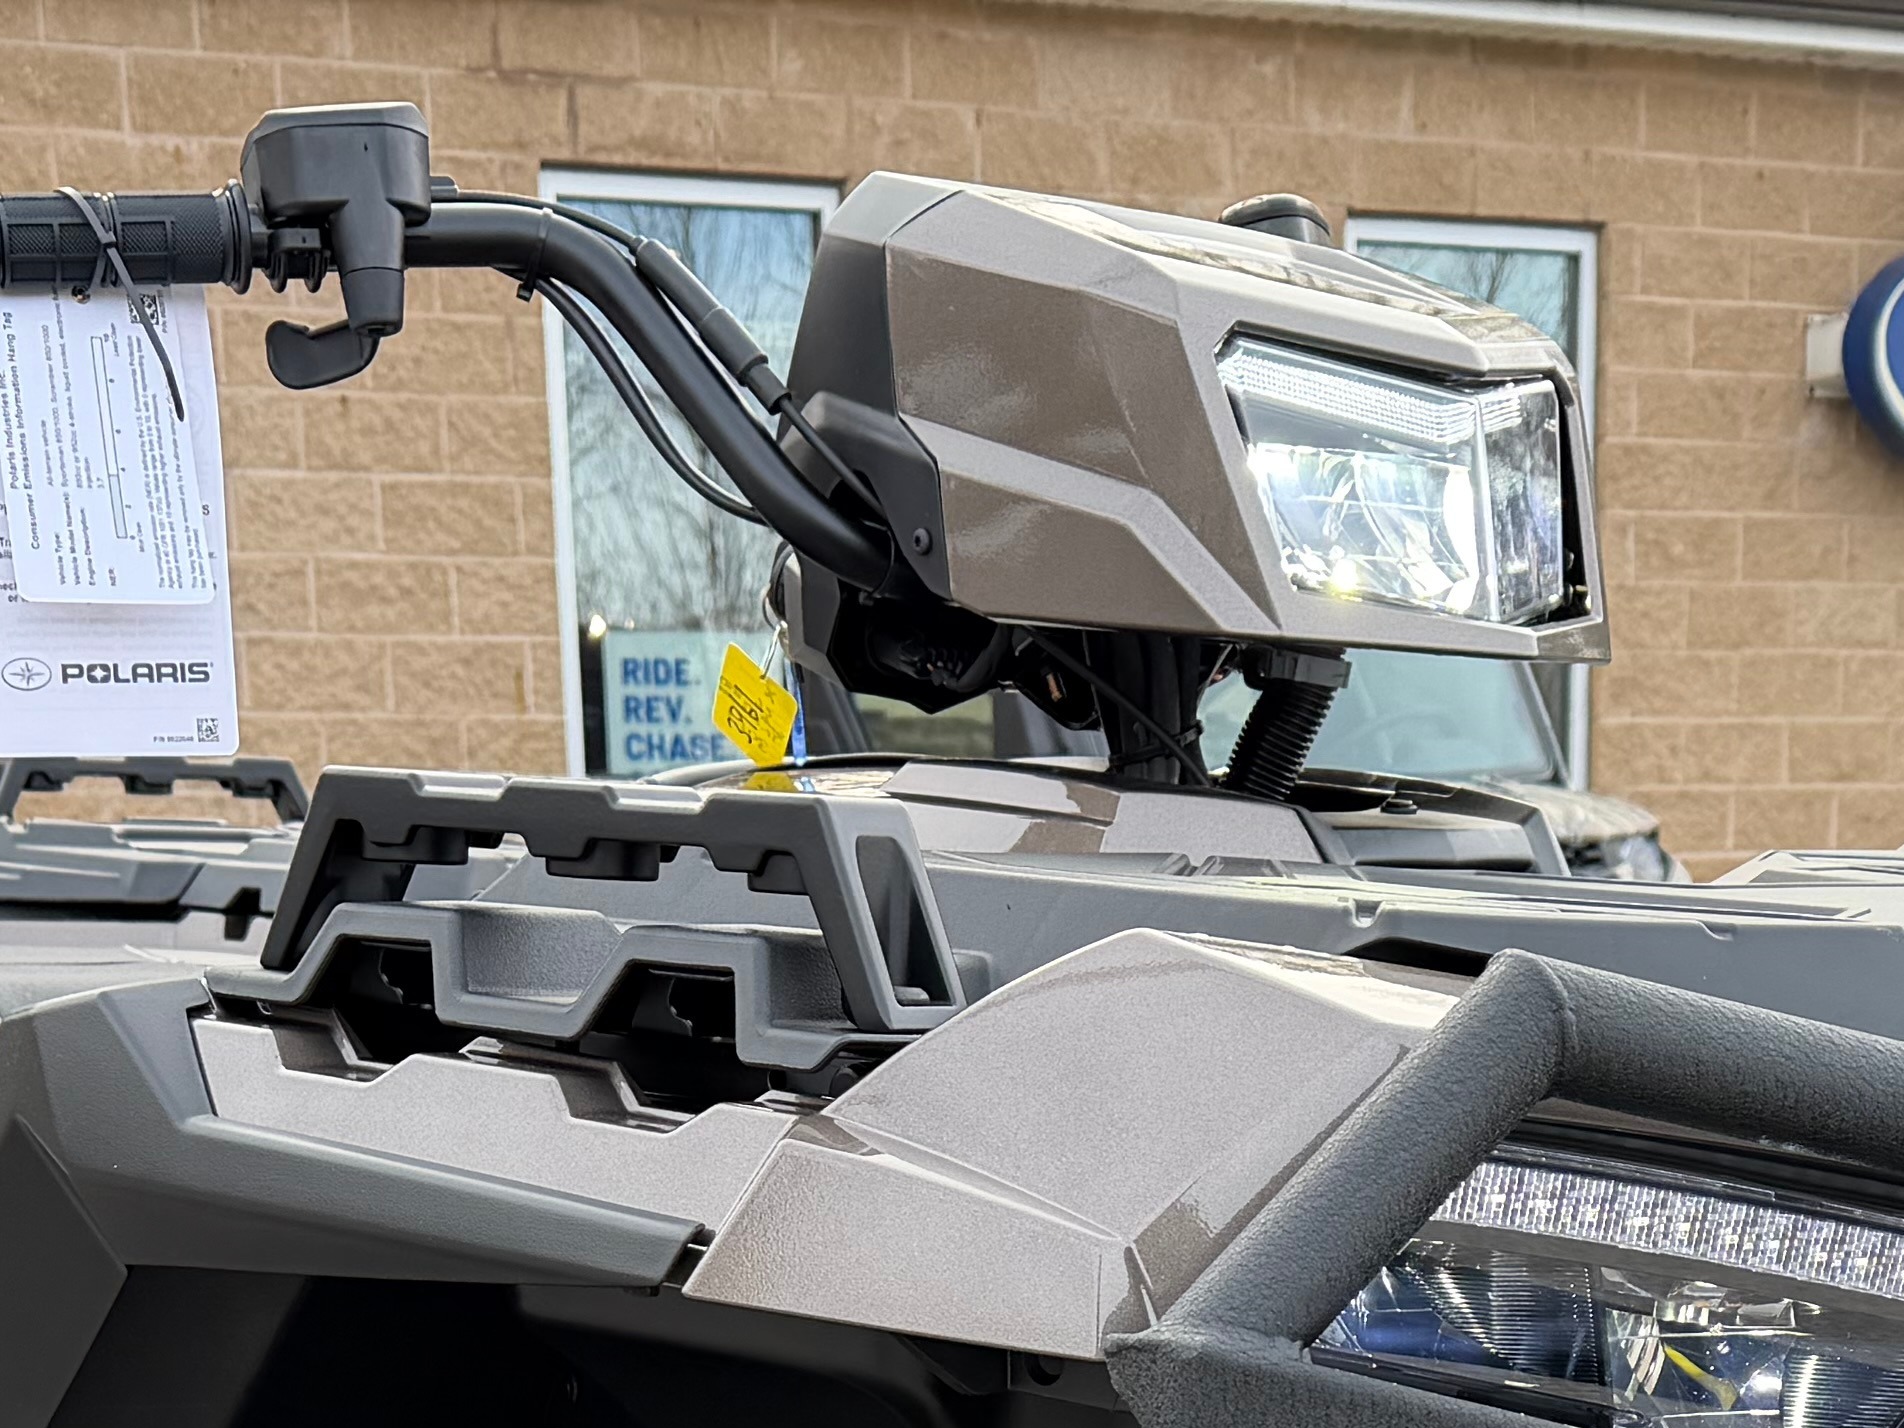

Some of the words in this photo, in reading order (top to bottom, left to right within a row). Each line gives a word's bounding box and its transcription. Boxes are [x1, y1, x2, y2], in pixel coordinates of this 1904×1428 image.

[1, 311, 13, 330] Tag
[4, 333, 17, 362] Hang
[9, 365, 24, 428] Information
[0, 392, 14, 448] Industries
[6, 451, 19, 489] Polaris
[17, 432, 32, 489] Emissions
[24, 492, 40, 550] Consumer
[61, 662, 211, 684] POLARIS
[622, 657, 701, 687] RIDE.
[624, 696, 693, 725] REV.
